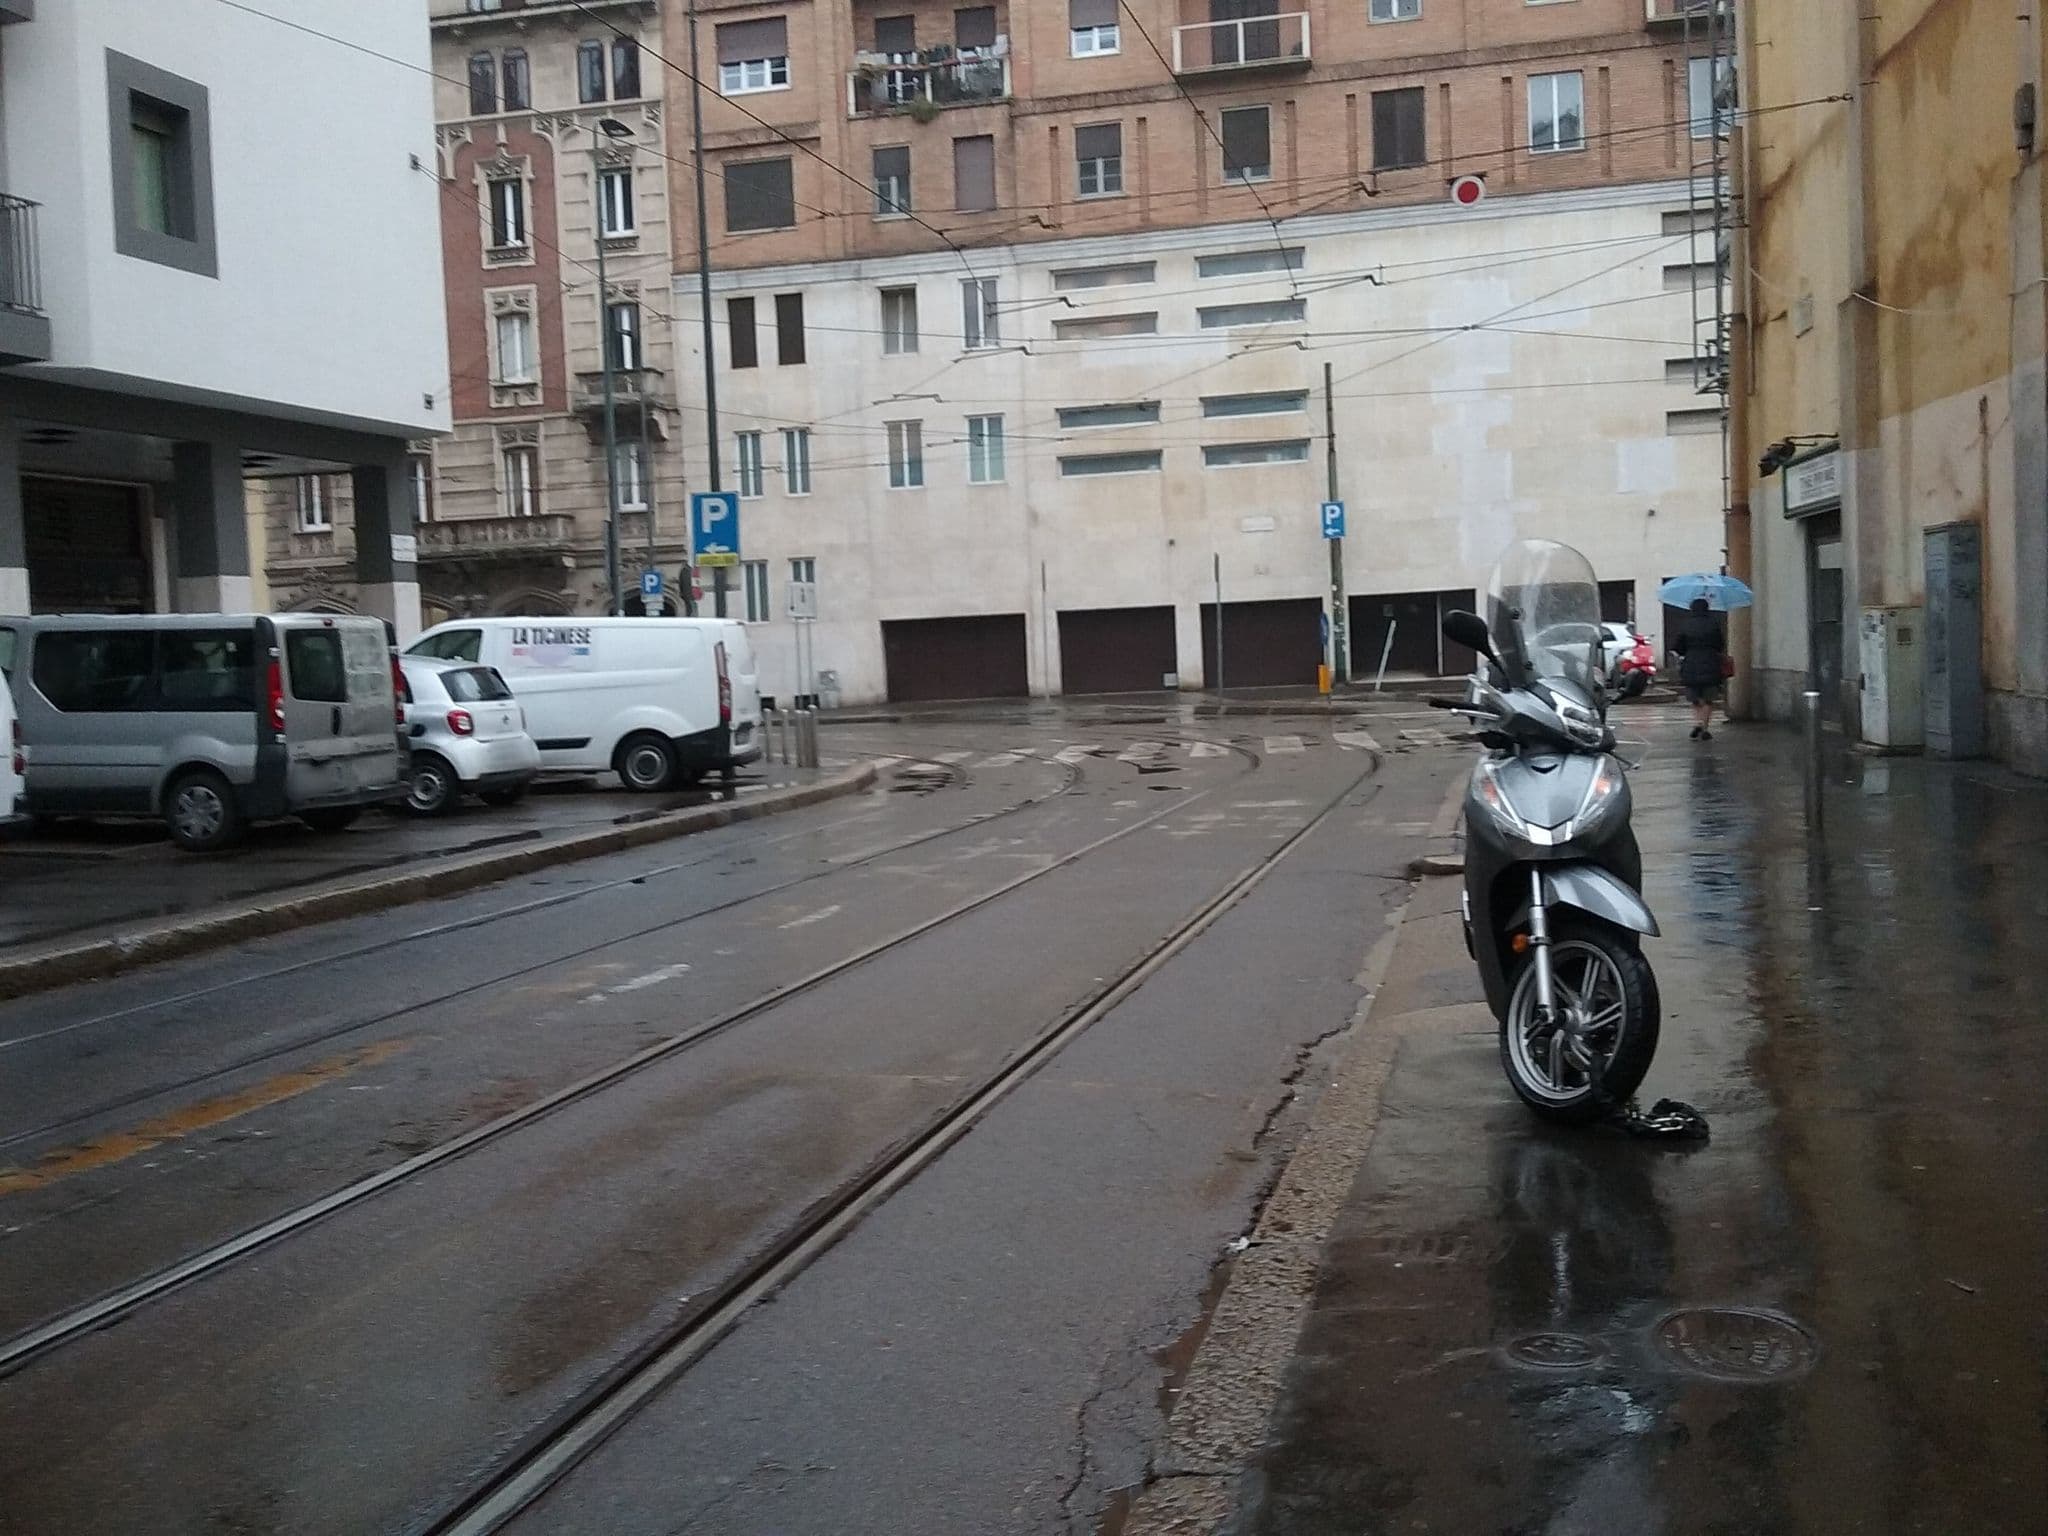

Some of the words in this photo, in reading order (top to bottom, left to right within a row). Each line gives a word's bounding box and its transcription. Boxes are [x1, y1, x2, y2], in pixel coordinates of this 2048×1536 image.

[702, 497, 729, 534] P
[1325, 505, 1341, 525] P
[644, 574, 659, 593] P
[512, 627, 528, 645] LA
